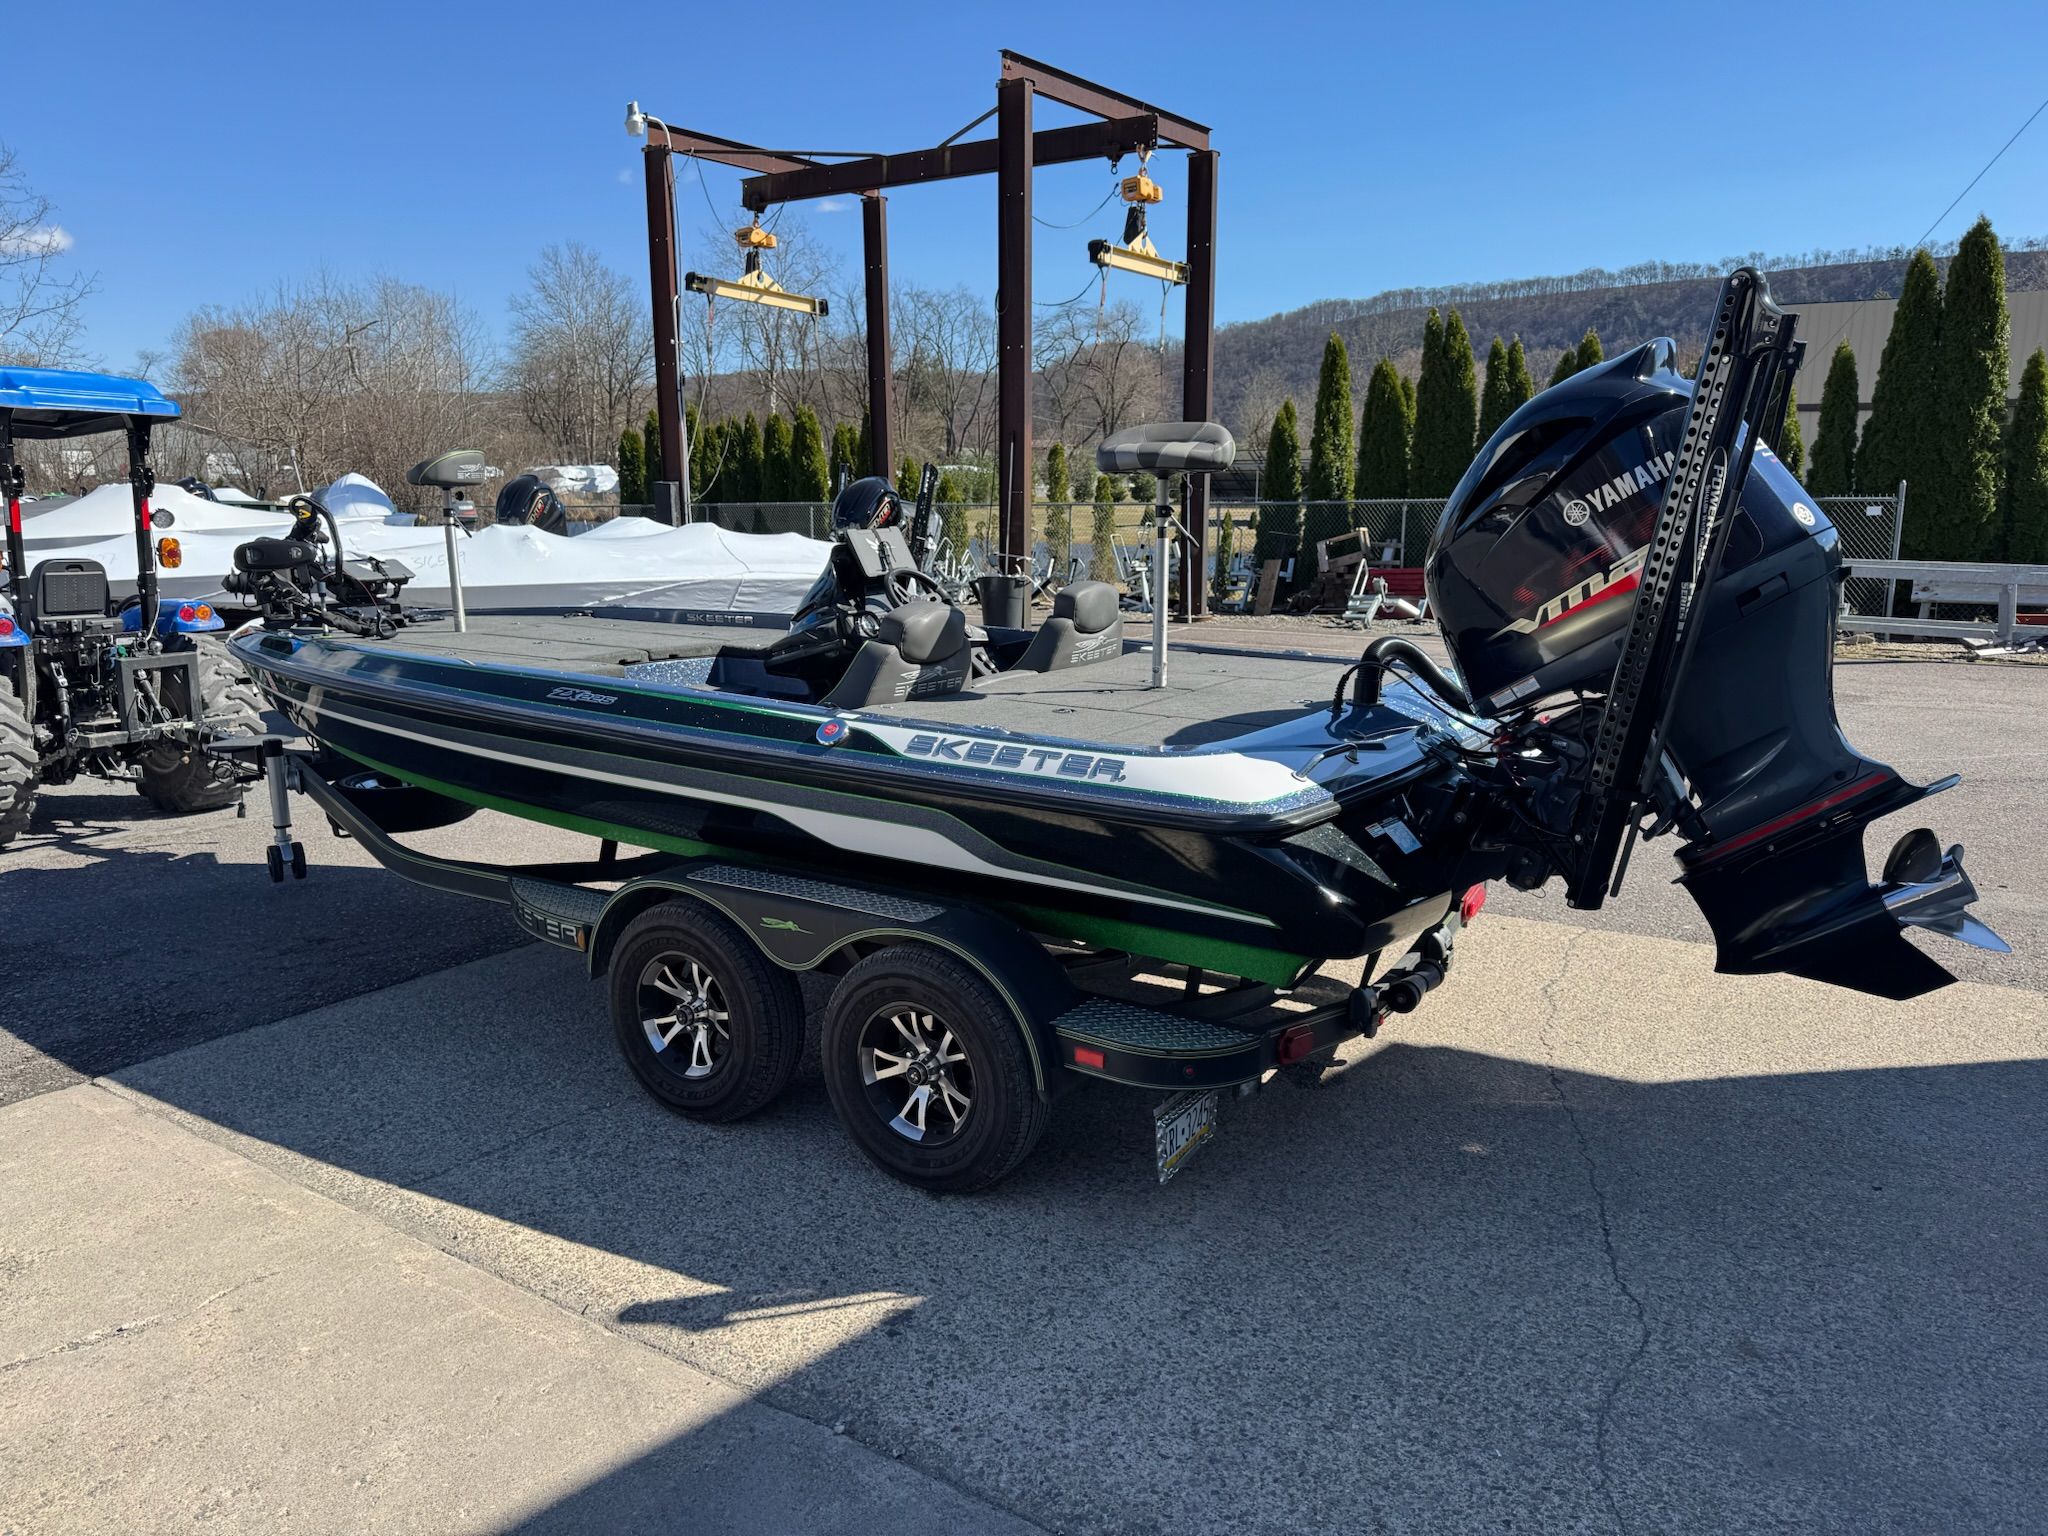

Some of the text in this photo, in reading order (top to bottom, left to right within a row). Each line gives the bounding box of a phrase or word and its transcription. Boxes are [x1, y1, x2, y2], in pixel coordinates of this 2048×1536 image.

[686, 613, 753, 625] SKEETER
[1070, 643, 1117, 664] SKEETER
[893, 676, 963, 697] SKEETER
[903, 734, 1127, 783] SKEETER
